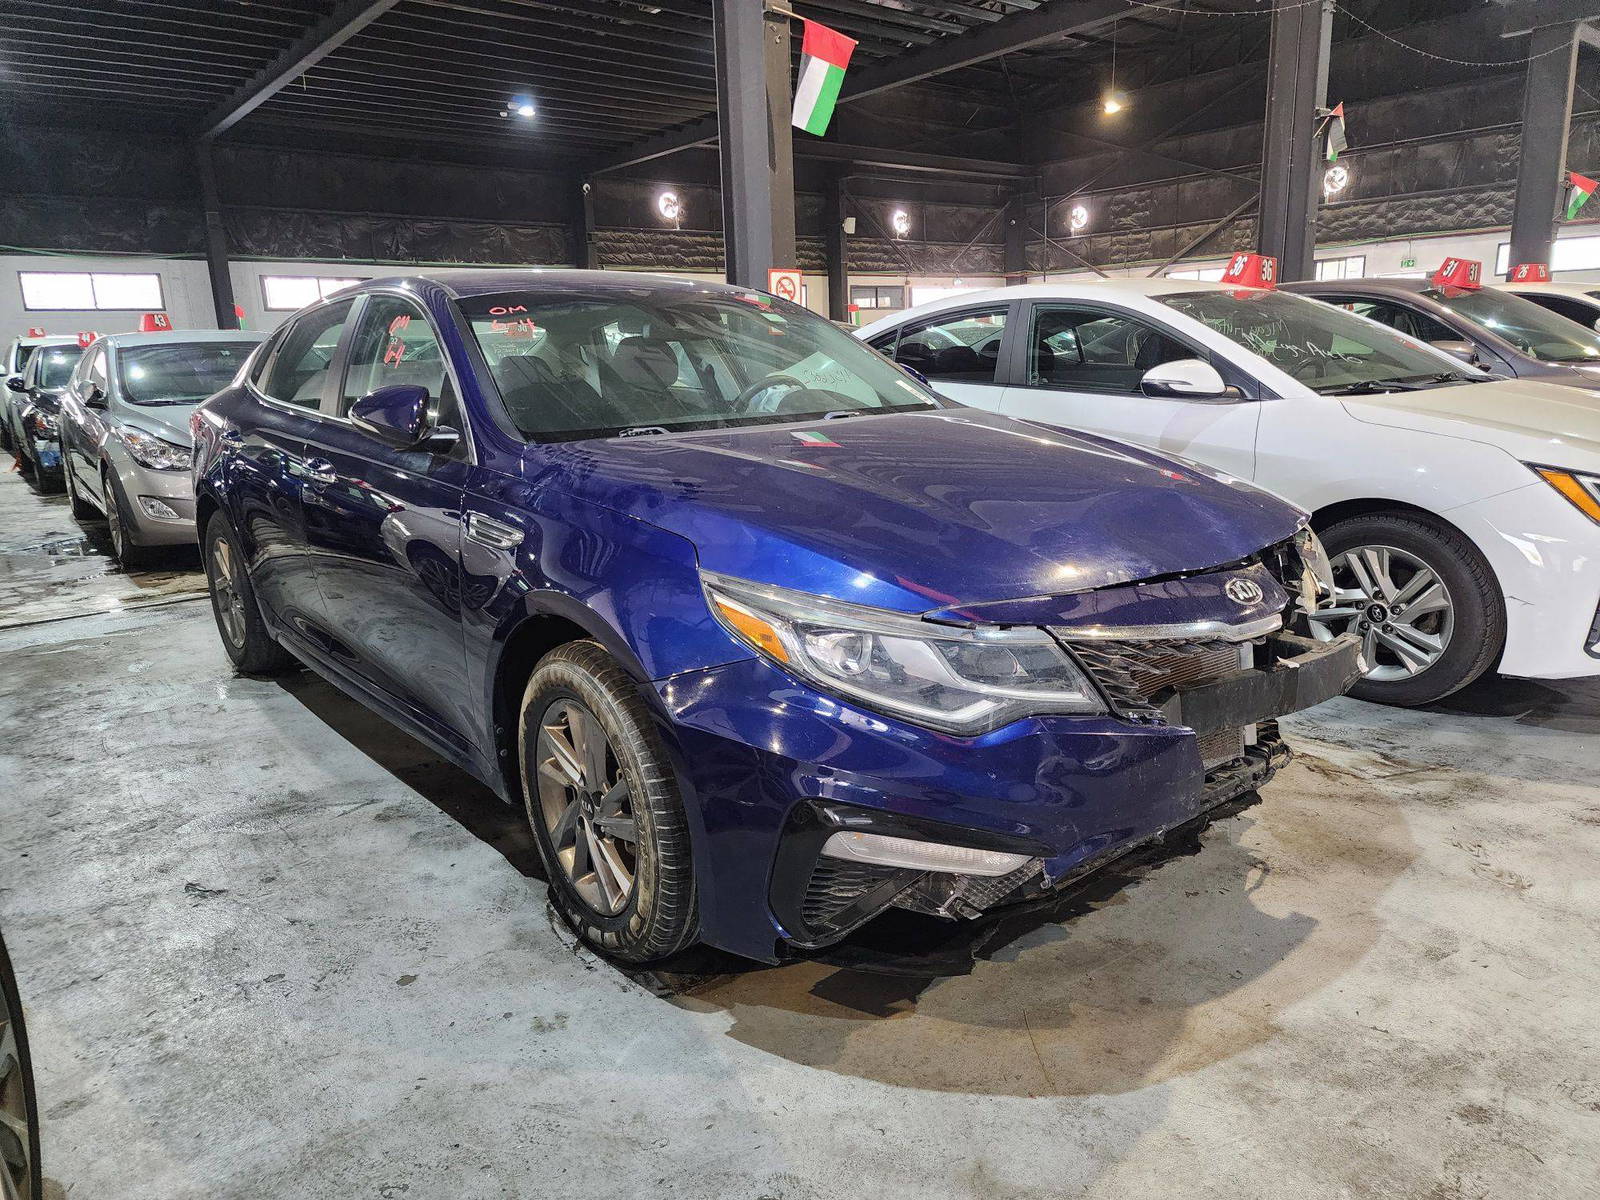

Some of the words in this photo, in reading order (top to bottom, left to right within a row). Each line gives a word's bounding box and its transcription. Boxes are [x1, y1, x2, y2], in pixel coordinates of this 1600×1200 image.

[1230, 256, 1248, 276] 36
[1262, 259, 1273, 281] 36
[1443, 260, 1460, 277] 31
[1469, 263, 1478, 280] 31
[489, 305, 528, 315] OM
[154, 314, 167, 327] 43
[1229, 580, 1261, 601] KIA
